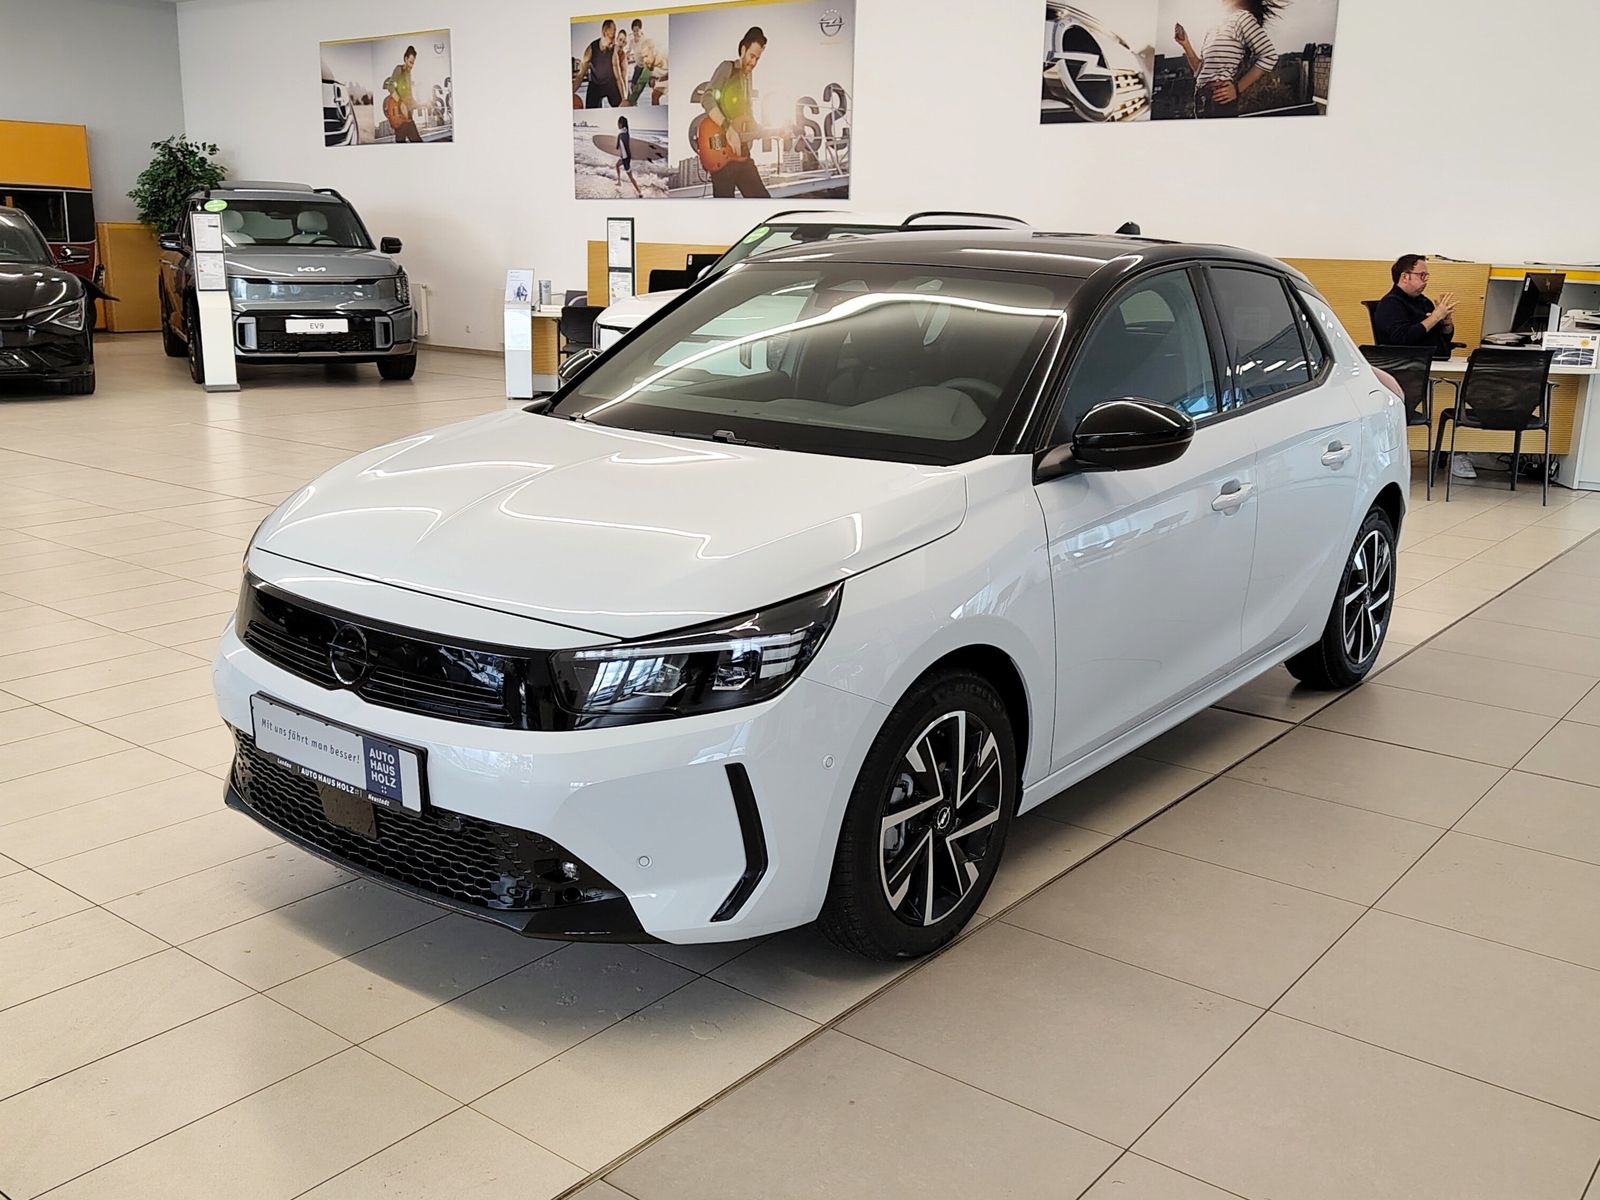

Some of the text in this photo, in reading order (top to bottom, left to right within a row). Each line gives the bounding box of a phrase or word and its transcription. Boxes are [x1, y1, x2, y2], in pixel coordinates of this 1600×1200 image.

[309, 322, 325, 330] EV9
[261, 717, 360, 764] Mit uns fährt man besser!
[369, 748, 395, 765] AUTO
[370, 759, 396, 777] HAUS
[301, 767, 317, 779] AUTO
[318, 774, 336, 787] HAUS
[336, 781, 355, 794] HOLZ
[371, 771, 397, 789] HOLZ
